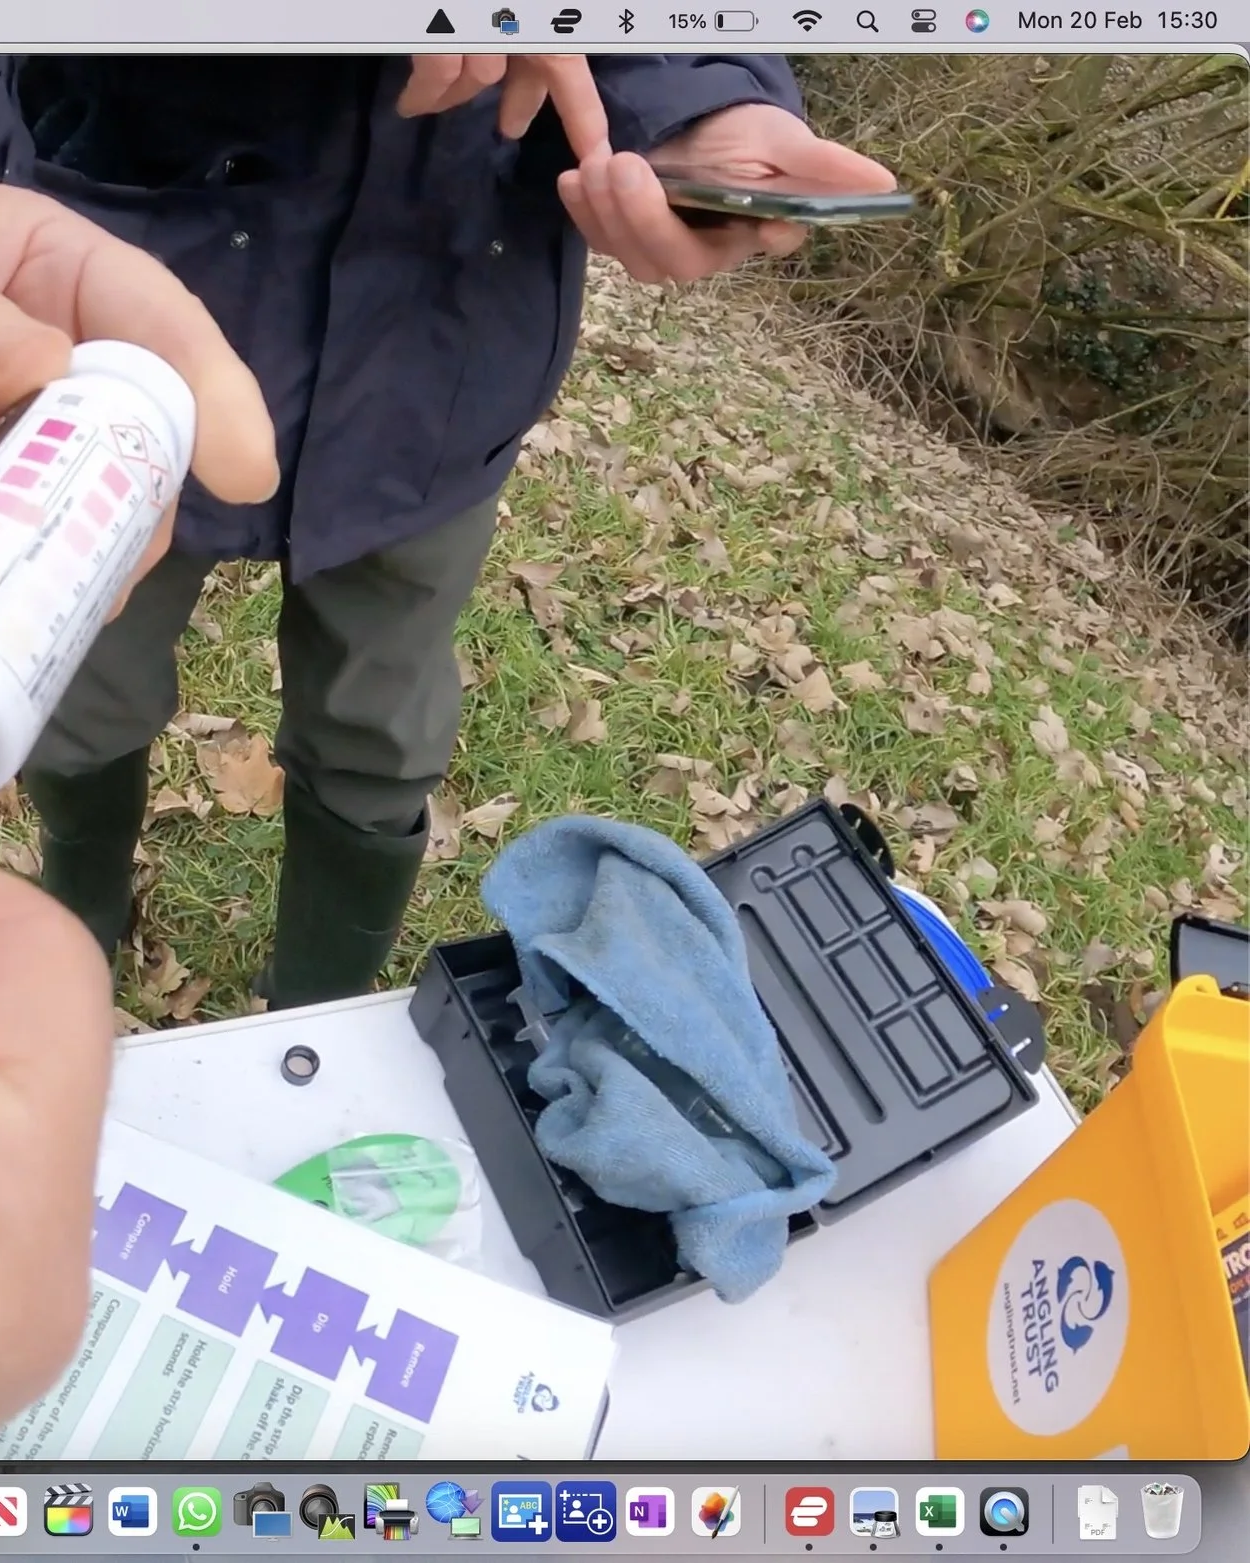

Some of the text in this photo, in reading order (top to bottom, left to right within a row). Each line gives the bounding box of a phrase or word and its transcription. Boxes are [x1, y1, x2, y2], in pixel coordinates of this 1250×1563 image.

[669, 14, 706, 28] 15%
[1019, 11, 1217, 28] Mon 20 Feb 15:30
[120, 1213, 150, 1259] Compare
[218, 1266, 238, 1294] Hold
[88, 1298, 121, 1347] Compare
[313, 1313, 329, 1333] Dip
[1021, 1281, 1043, 1377] TRUST
[1032, 1259, 1059, 1393] ANGLING
[188, 1339, 208, 1368] Hold
[1004, 1282, 1021, 1405] anglingtrust.net
[77, 1349, 93, 1369] the
[162, 1332, 190, 1377] seconds
[400, 1342, 426, 1388] Remove
[58, 1370, 82, 1406] colour
[177, 1368, 194, 1388] the
[163, 1389, 182, 1416] strip
[264, 1377, 285, 1411] shake
[286, 1384, 303, 1405] Dip
[49, 1406, 60, 1422] of
[256, 1412, 269, 1431] off
[277, 1407, 293, 1427] the
[16, 1425, 29, 1442] on
[37, 1421, 54, 1442] the
[246, 1431, 262, 1450] the
[264, 1428, 282, 1455] strip
[115, 1505, 129, 1517] W
[520, 1501, 538, 1510] ABC
[634, 1506, 644, 1517] N
[924, 1505, 934, 1517] X
